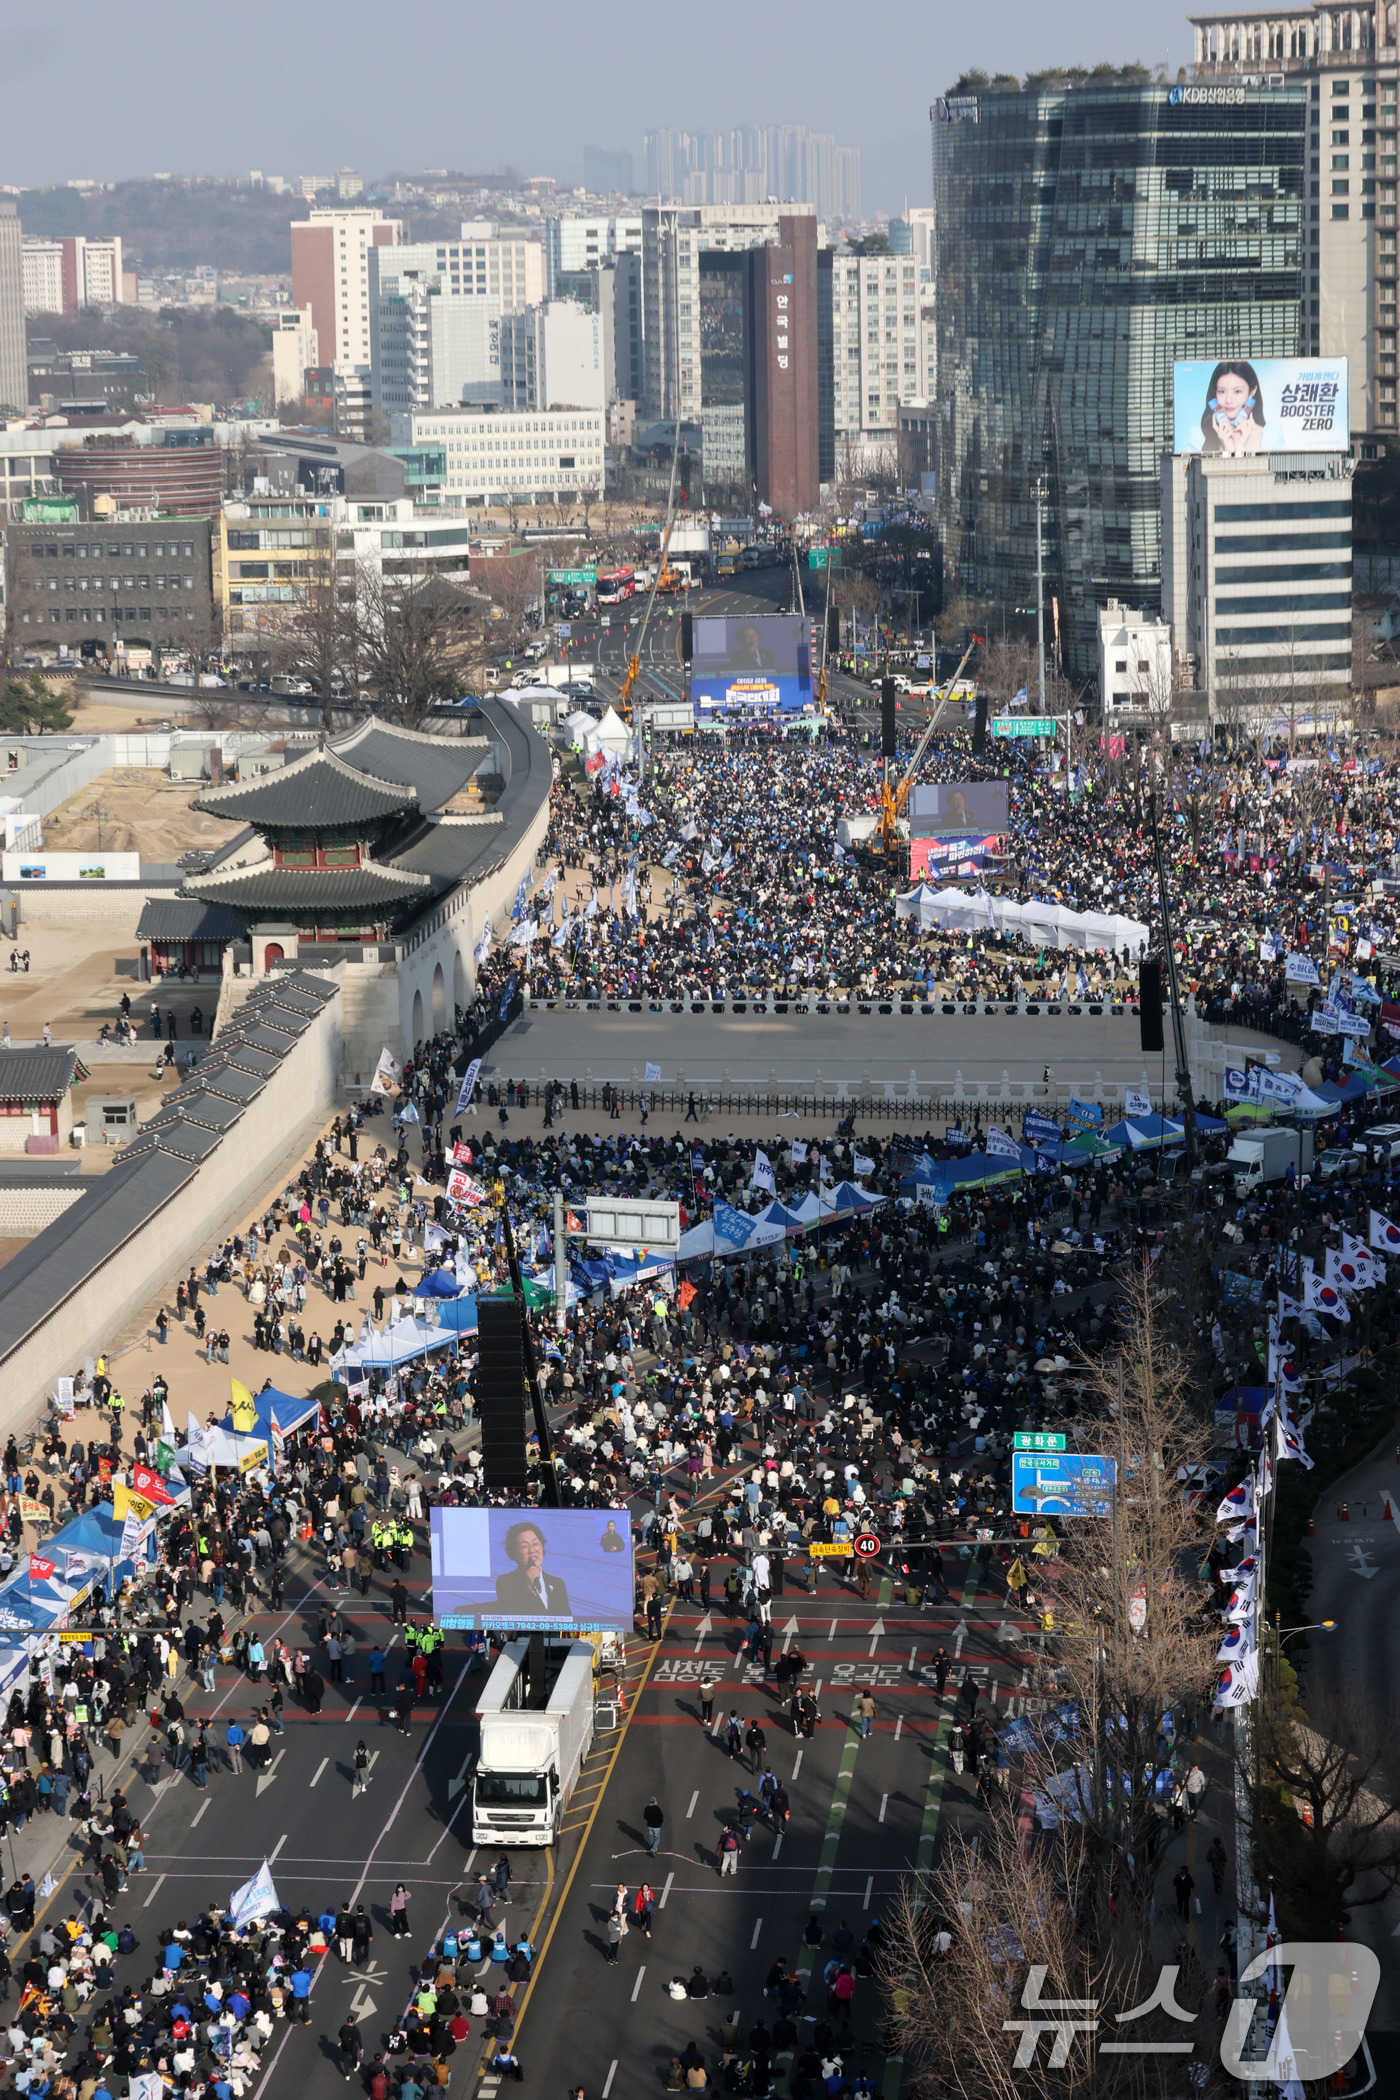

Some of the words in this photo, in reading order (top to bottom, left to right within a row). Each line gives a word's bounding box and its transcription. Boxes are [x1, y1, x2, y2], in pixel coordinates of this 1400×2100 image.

[776, 295, 789, 369] 안국빌딩
[1281, 383, 1339, 403] 상쾌환
[1280, 404, 1335, 418] BOOSTER
[1302, 418, 1333, 431] ZERO
[721, 1207, 751, 1231] 통일시대
[721, 1222, 743, 1240] 연구원
[1021, 1435, 1058, 1447] 광화문
[811, 1545, 851, 1555] 과속단속장비
[860, 1540, 875, 1551] 40
[440, 1617, 475, 1629] 비상행동
[481, 1621, 515, 1630] 카카오뱅크
[516, 1622, 579, 1631] 7942-09-53862
[653, 1659, 727, 1683] 삼청동
[830, 1663, 903, 1687] 율곡로
